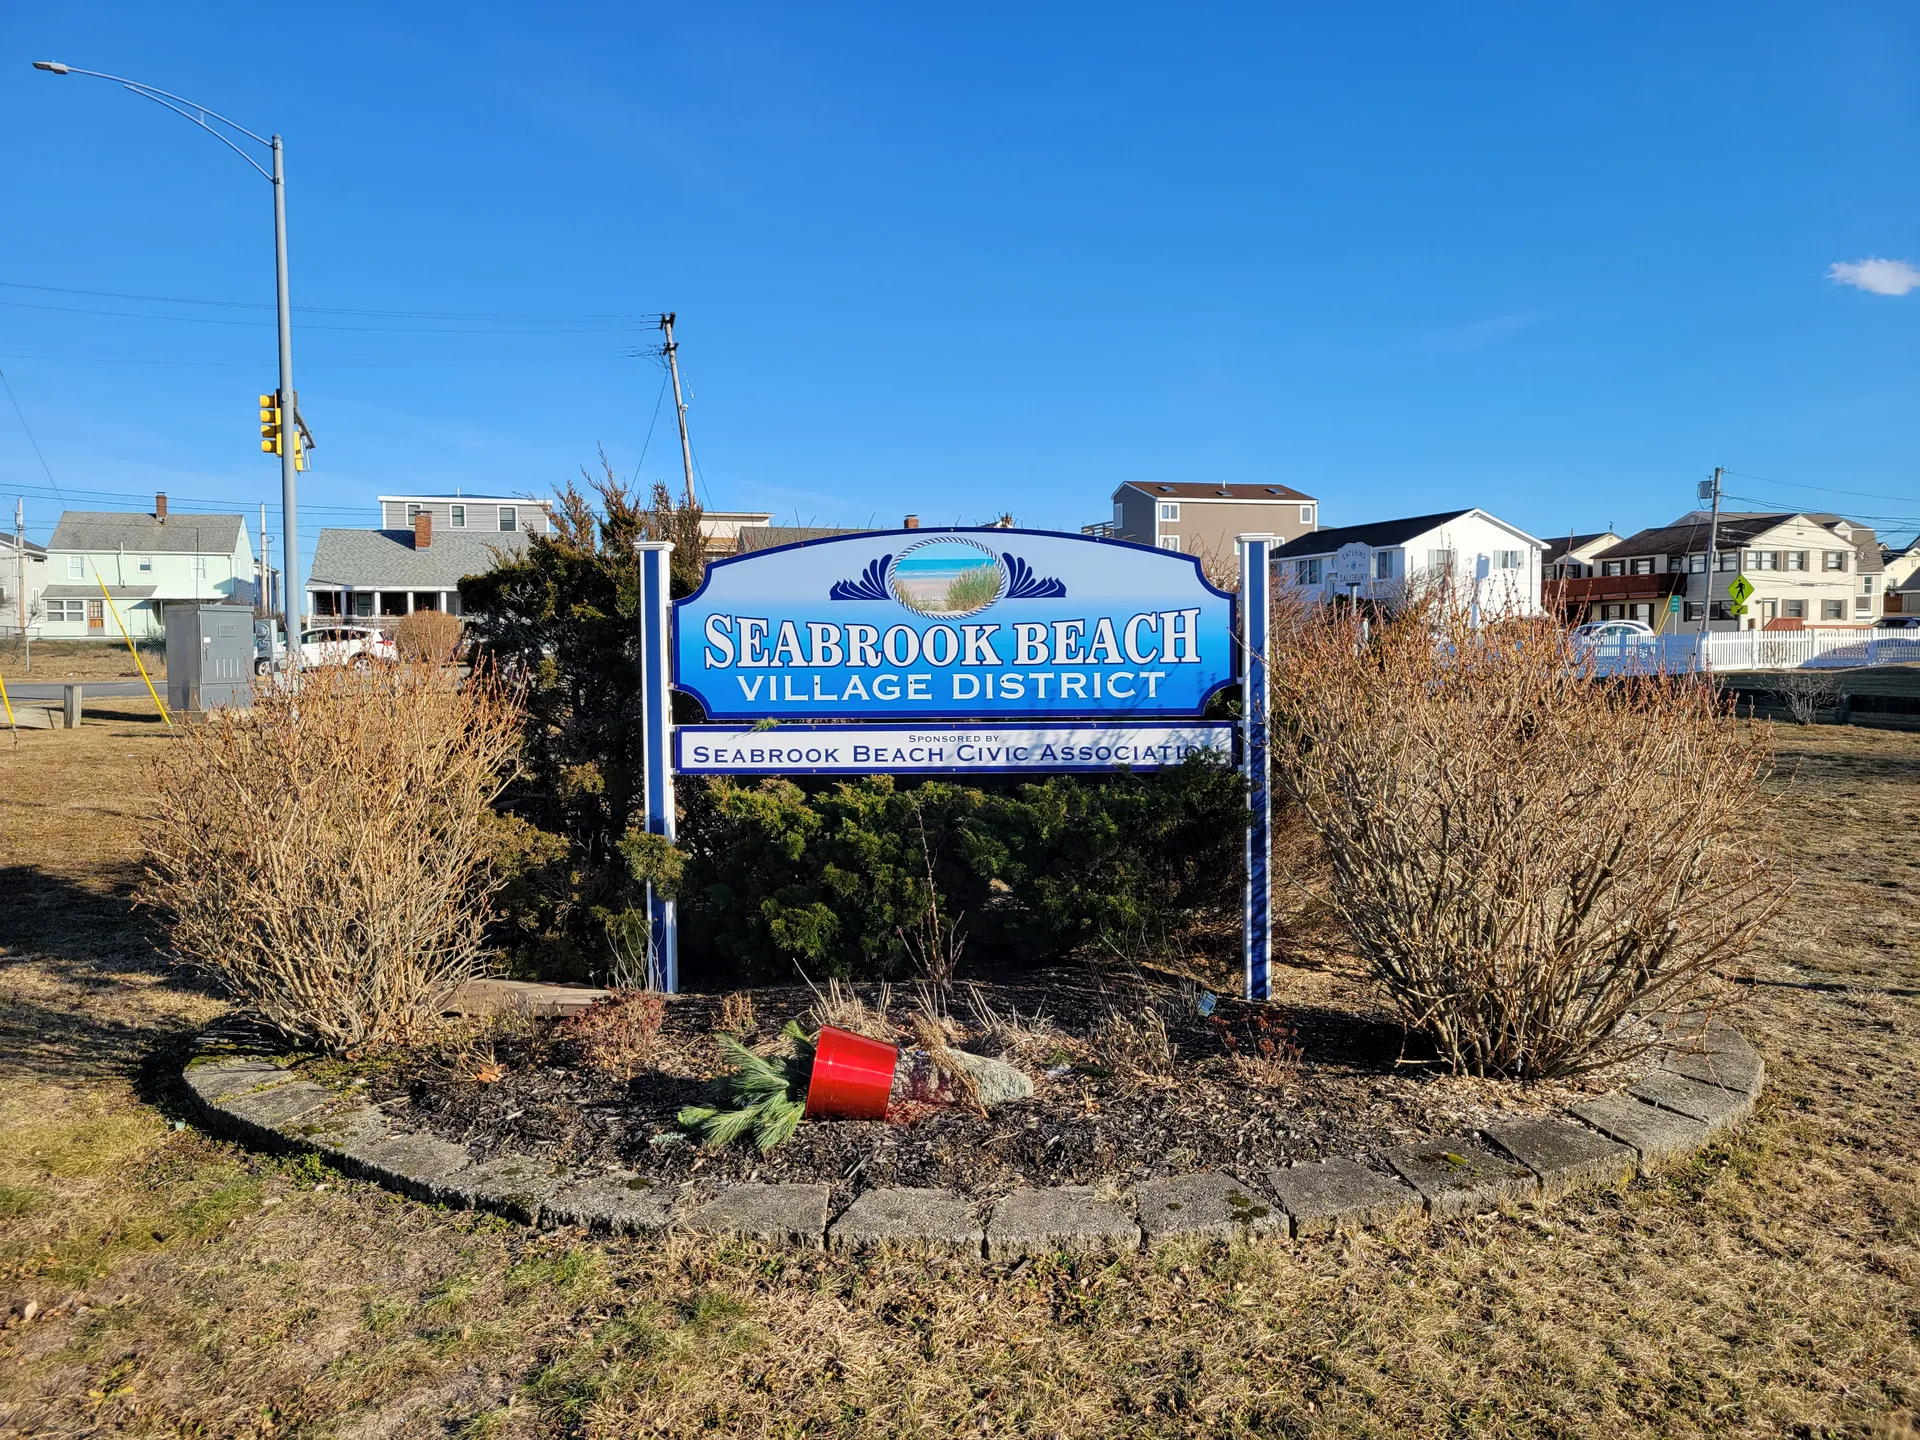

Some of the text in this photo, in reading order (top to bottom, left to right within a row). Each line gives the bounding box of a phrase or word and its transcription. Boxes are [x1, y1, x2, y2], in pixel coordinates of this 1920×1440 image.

[1342, 549, 1367, 560] ENTERING
[1340, 573, 1368, 582] SALISBURY
[704, 607, 1202, 669] SEABROOK BEACH
[736, 671, 1166, 701] VILLAGE DISTRICT
